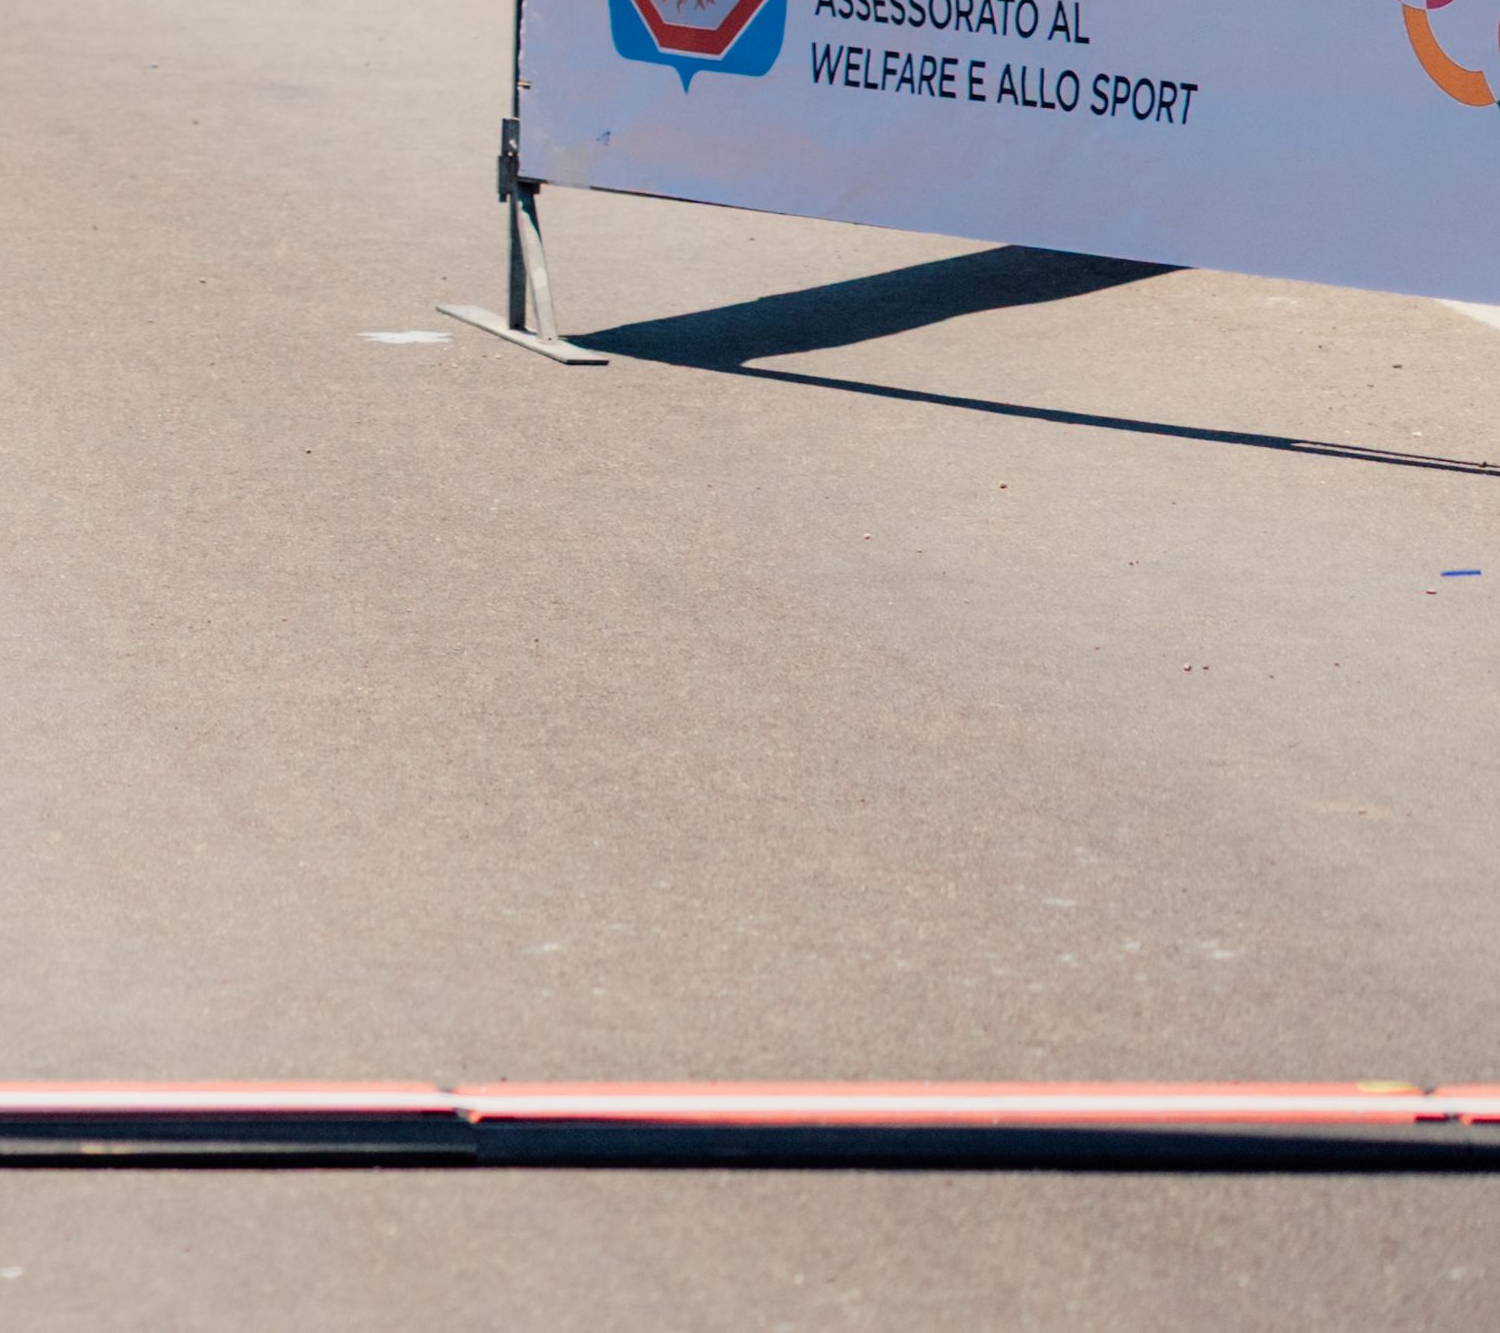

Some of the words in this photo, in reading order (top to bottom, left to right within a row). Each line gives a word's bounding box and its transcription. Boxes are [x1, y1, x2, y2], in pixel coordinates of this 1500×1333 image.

[1048, 0, 1091, 44] AL
[811, 42, 959, 99] WELFARE
[968, 60, 987, 102] E
[997, 63, 1080, 112] ALLO
[1090, 73, 1199, 125] SPORT
